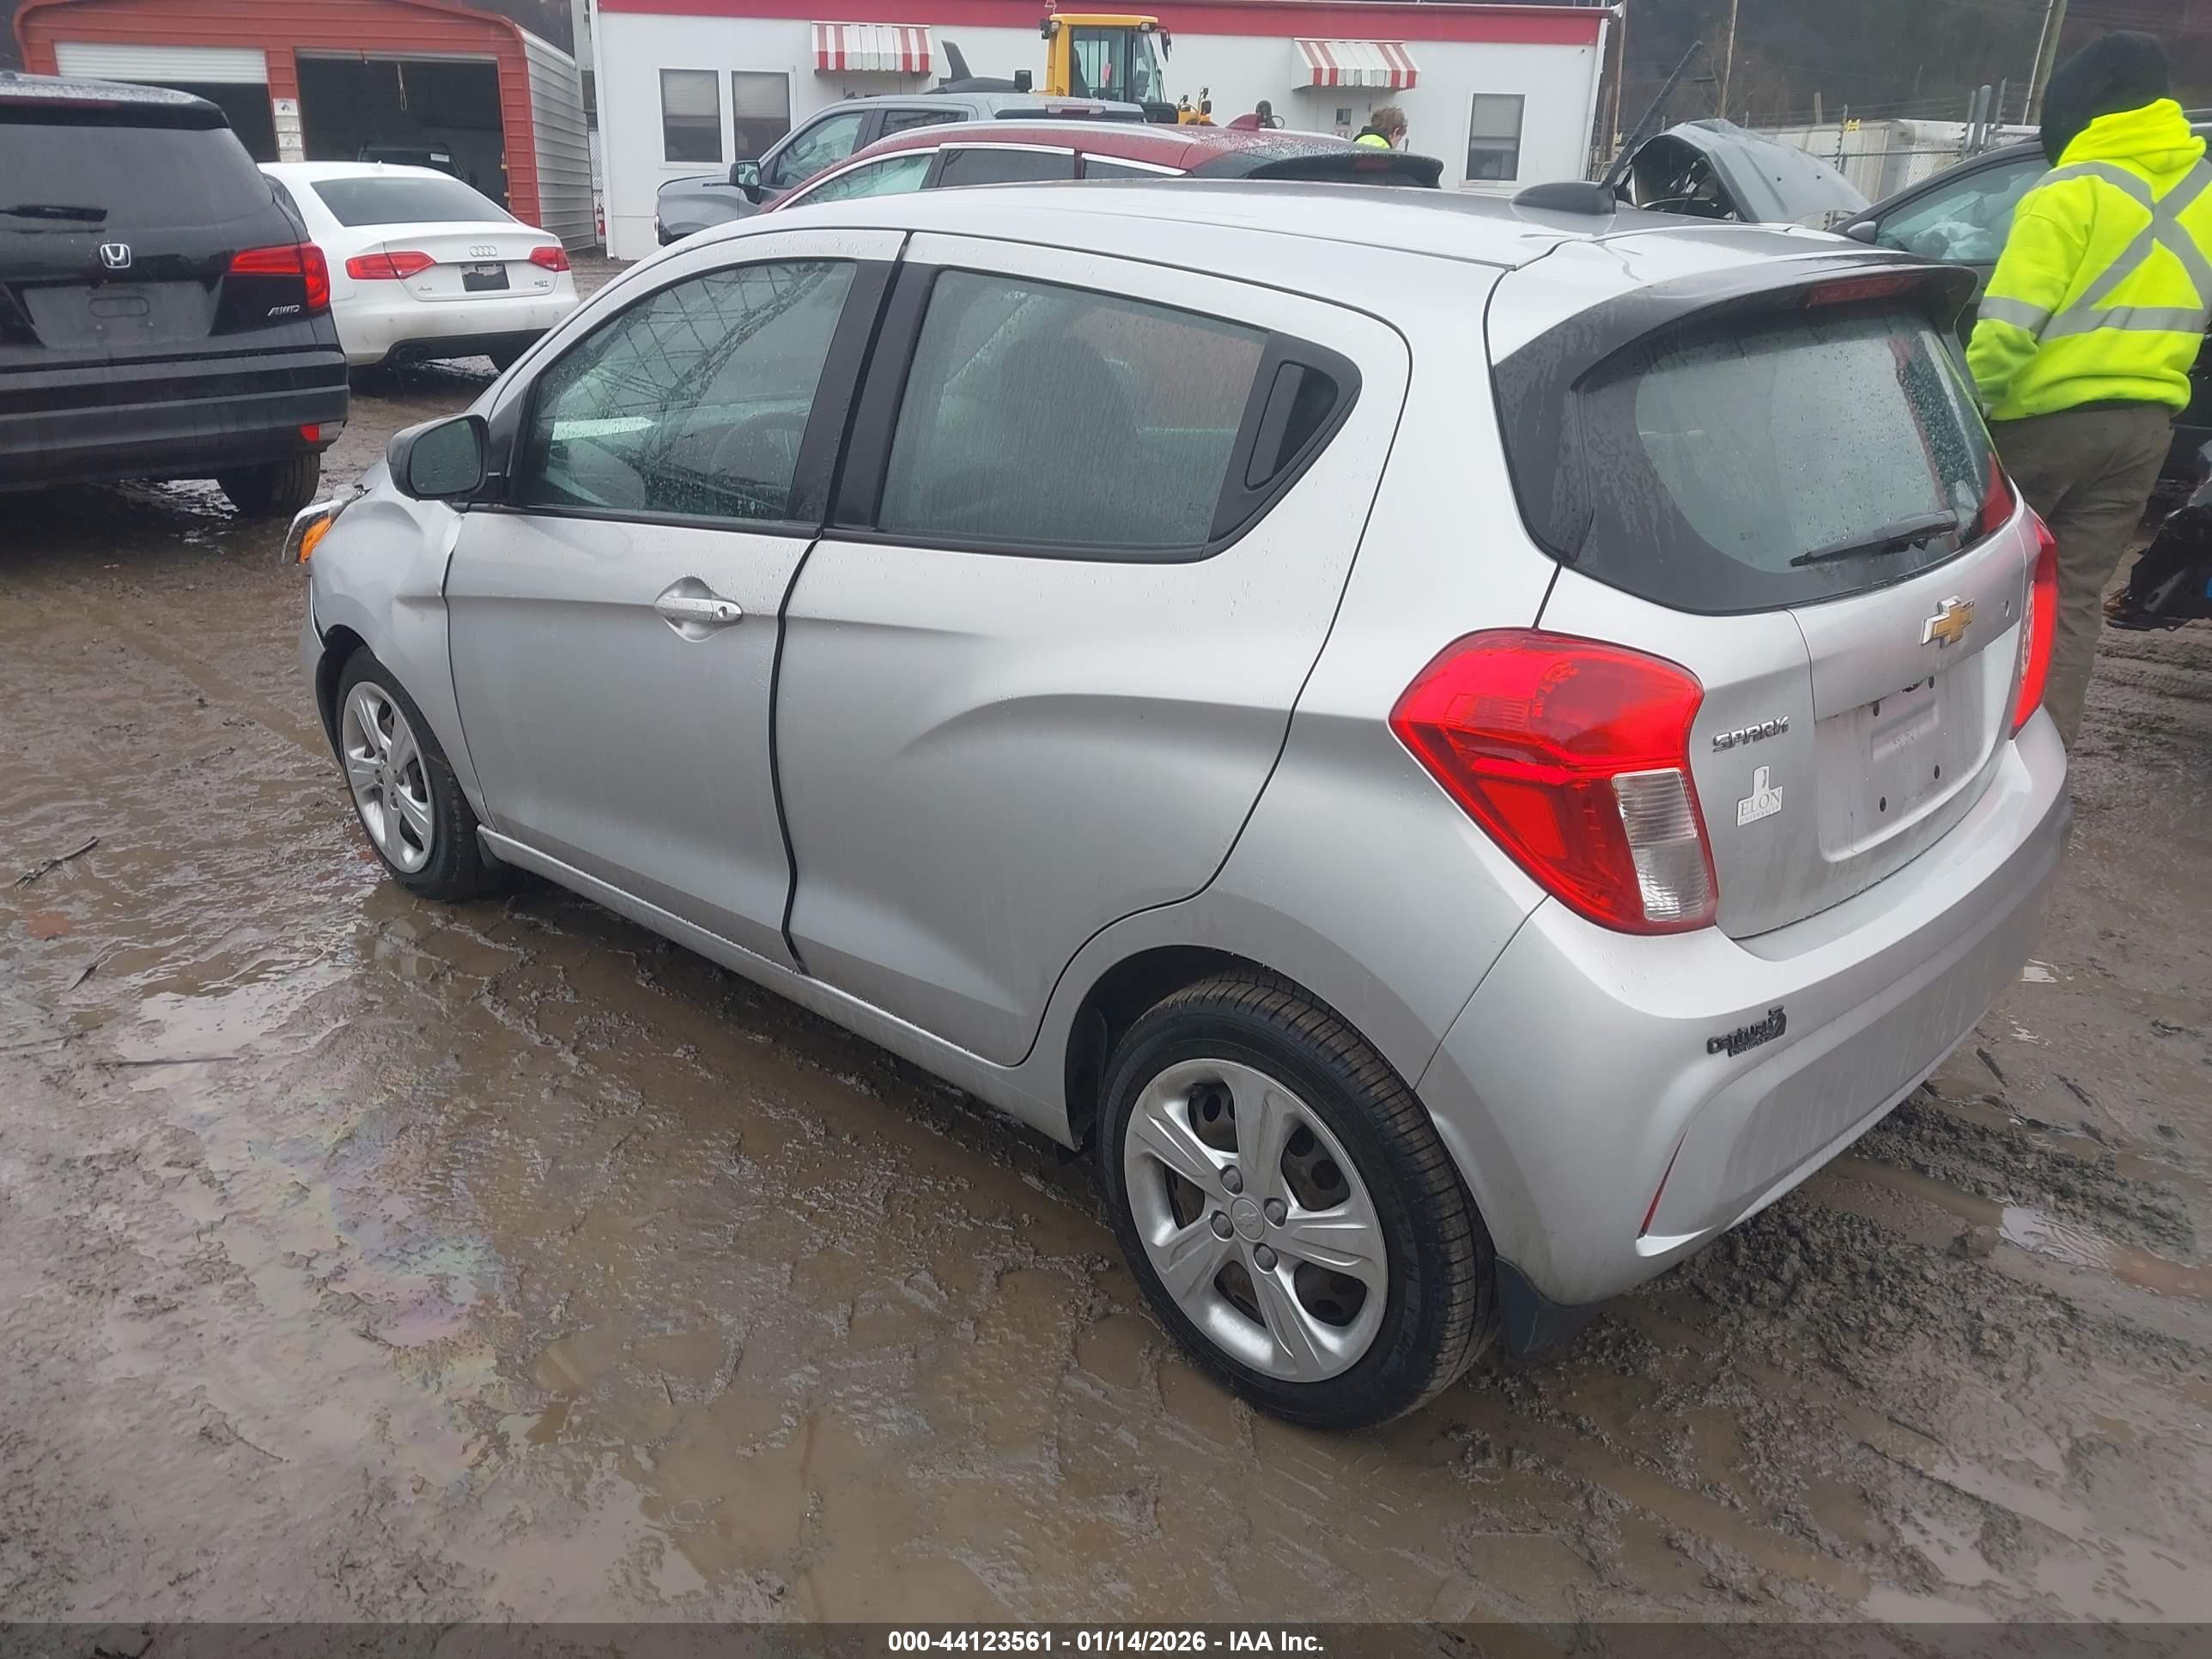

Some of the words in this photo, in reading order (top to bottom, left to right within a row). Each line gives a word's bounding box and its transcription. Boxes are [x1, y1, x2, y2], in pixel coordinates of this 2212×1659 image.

[267, 304, 301, 317] AWD
[1711, 715, 1789, 752] SPARK
[1740, 788, 1782, 816] ELON
